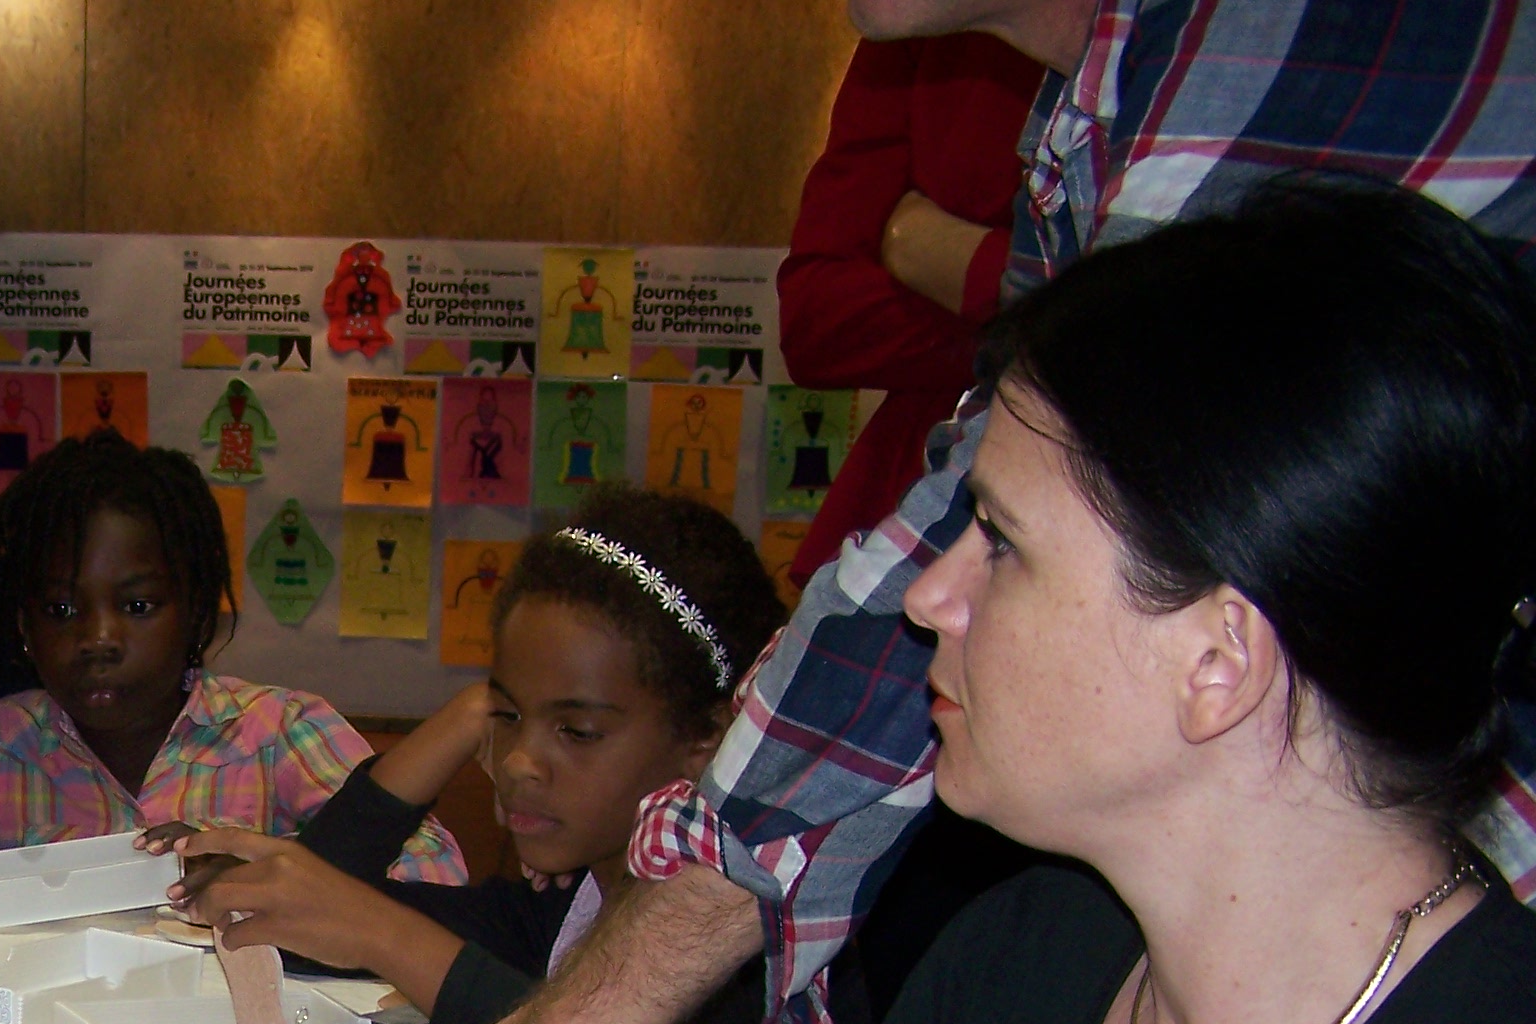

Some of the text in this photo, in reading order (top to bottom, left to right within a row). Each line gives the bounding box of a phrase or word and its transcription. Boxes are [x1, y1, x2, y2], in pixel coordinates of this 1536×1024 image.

[183, 272, 267, 290] Journées
[406, 277, 491, 295] Journées
[183, 288, 301, 308] Européennes
[634, 284, 718, 302] Journées
[406, 293, 526, 314] Européennes
[633, 300, 753, 321] Européennes
[183, 304, 311, 322] du Patrimoine
[406, 310, 535, 328] du Patrimoine
[632, 315, 763, 335] du Patrimoine
